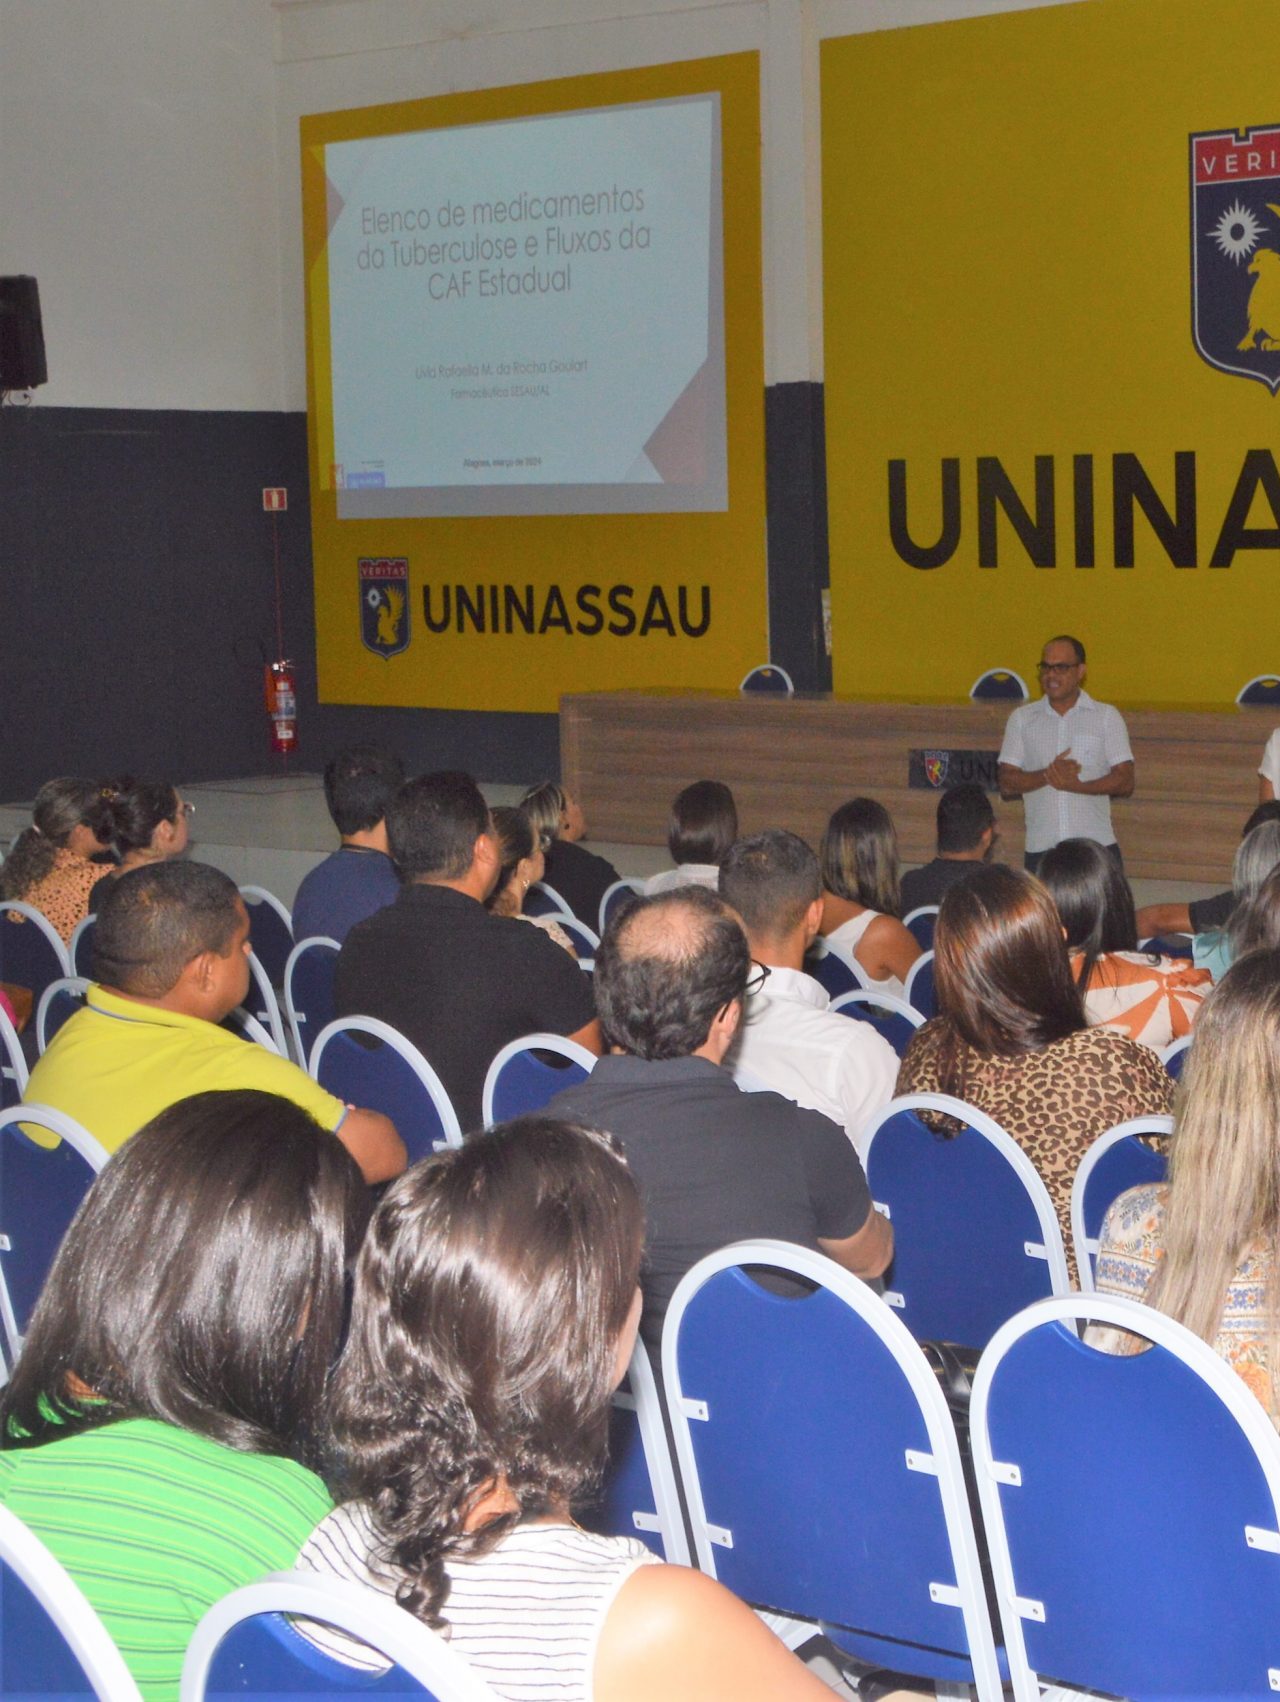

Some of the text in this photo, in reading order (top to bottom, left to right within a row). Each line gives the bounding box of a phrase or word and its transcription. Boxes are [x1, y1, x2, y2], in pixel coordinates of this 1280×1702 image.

[361, 184, 645, 235] Elenco de medicamentos
[357, 220, 651, 271] da Tuberculose e Fluxos da
[428, 263, 572, 301] CAF Estadual
[496, 361, 510, 376] da
[513, 359, 547, 375] Rocha
[361, 566, 405, 576] VERITAS
[422, 584, 711, 637] UNINASSAU
